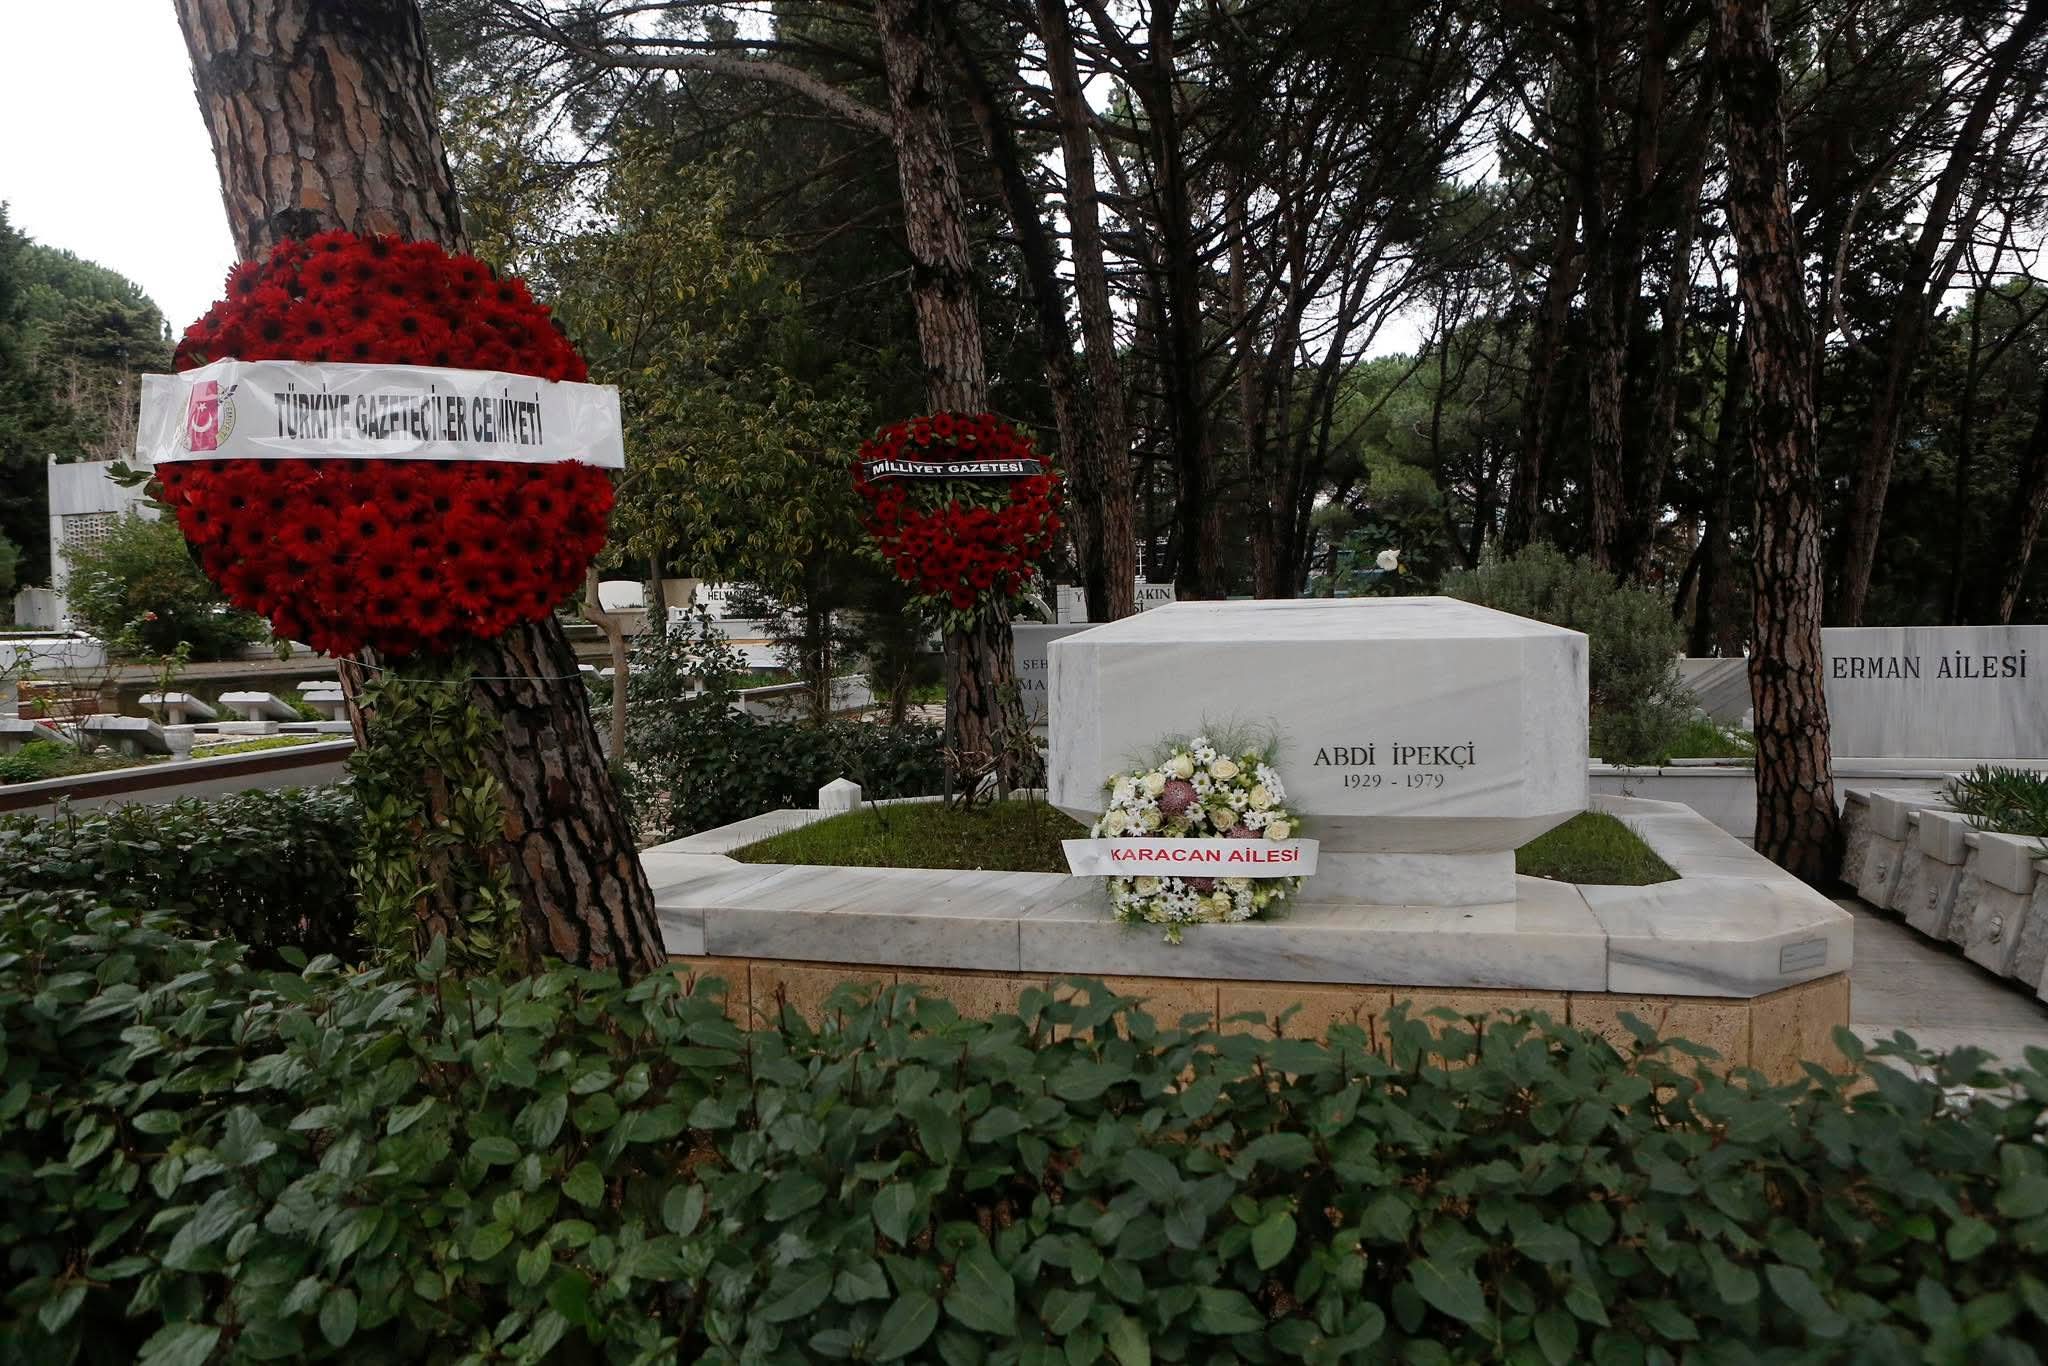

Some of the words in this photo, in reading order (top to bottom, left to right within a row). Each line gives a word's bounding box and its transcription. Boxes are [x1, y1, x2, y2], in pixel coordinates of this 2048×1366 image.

[274, 383, 350, 440] TÜRKİYE
[355, 384, 469, 442] GAZETECİLER
[472, 388, 543, 446] CEMİYETİ
[872, 460, 943, 475] MİLLİYET
[948, 461, 1024, 473] GAZETESİ
[1832, 656, 1920, 679] ERMAN
[1936, 649, 2027, 679] AİLESİ
[1313, 742, 1377, 766] ABDİ
[1392, 741, 1477, 770] İPEKÇİ
[1344, 774, 1382, 789] 1929
[1407, 773, 1444, 789] 1979
[1111, 848, 1221, 862] KARACAN
[1228, 846, 1299, 863] AİLESİ
